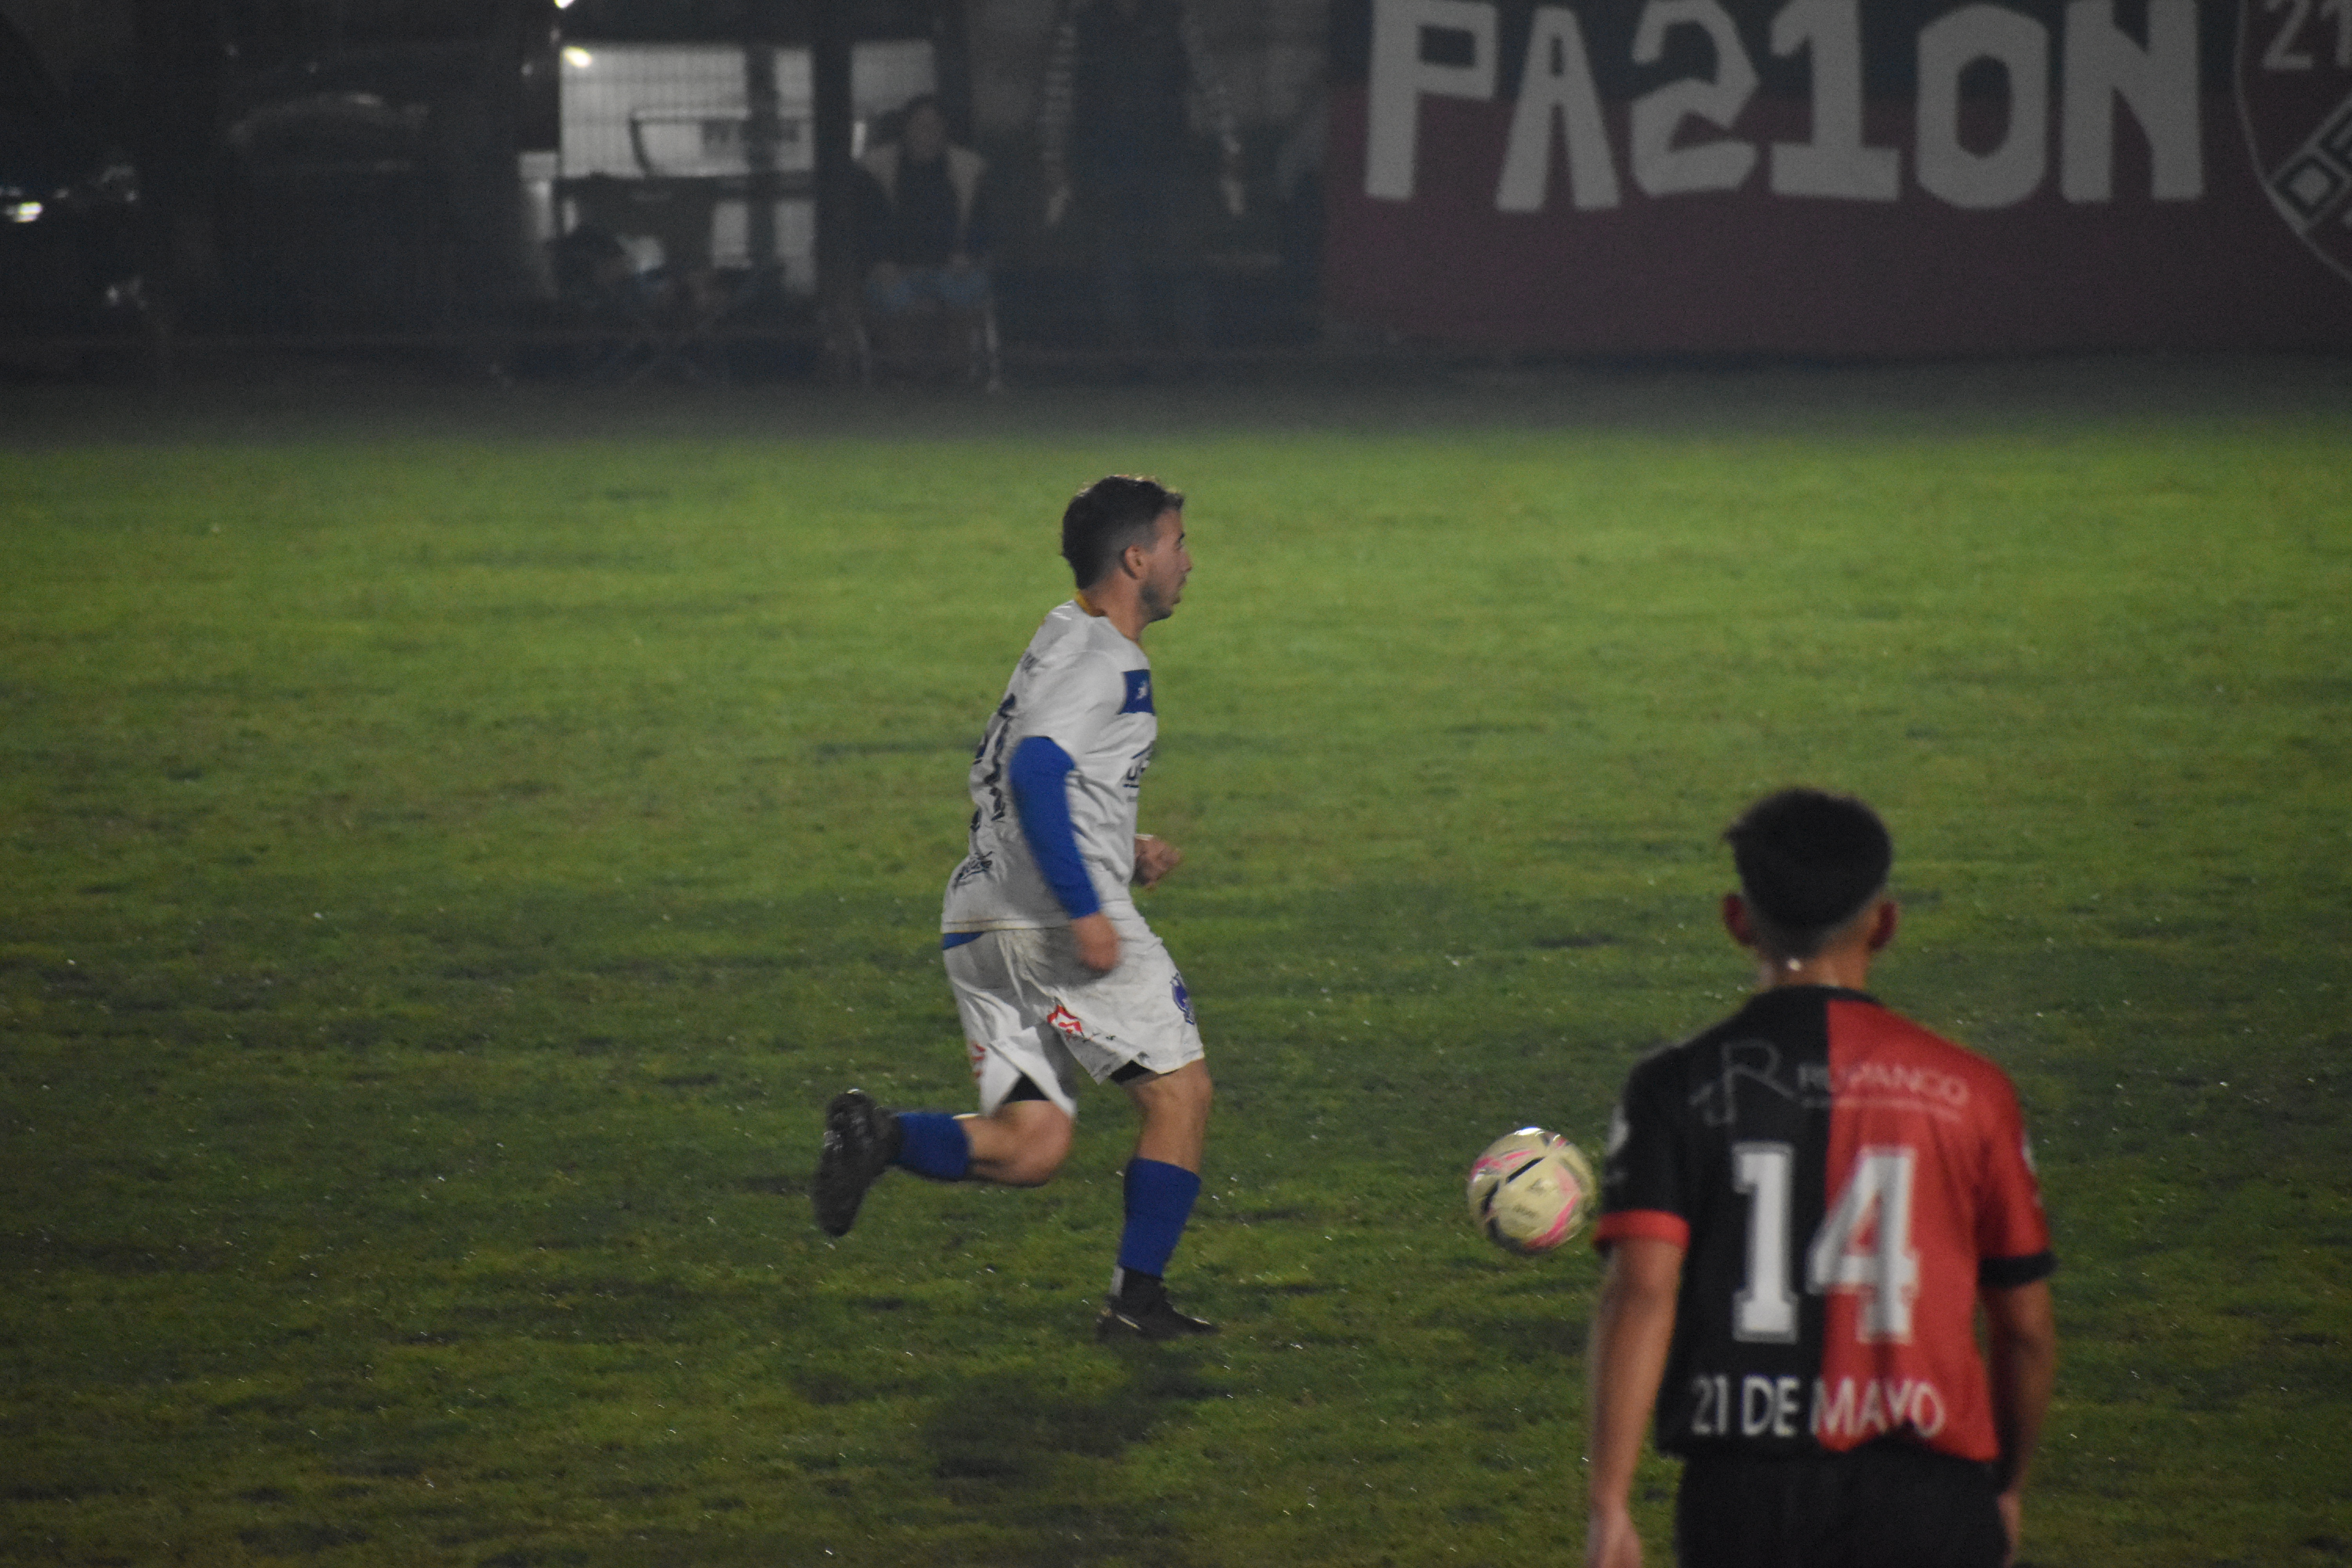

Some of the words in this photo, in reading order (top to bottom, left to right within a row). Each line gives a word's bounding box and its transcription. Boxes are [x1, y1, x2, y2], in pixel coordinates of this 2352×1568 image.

[2263, 0, 2352, 71] 21
[1732, 1140, 1920, 1345] 14
[1691, 1374, 1729, 1436] 21
[1742, 1373, 1801, 1437] DE
[1809, 1374, 1947, 1439] MAYO
